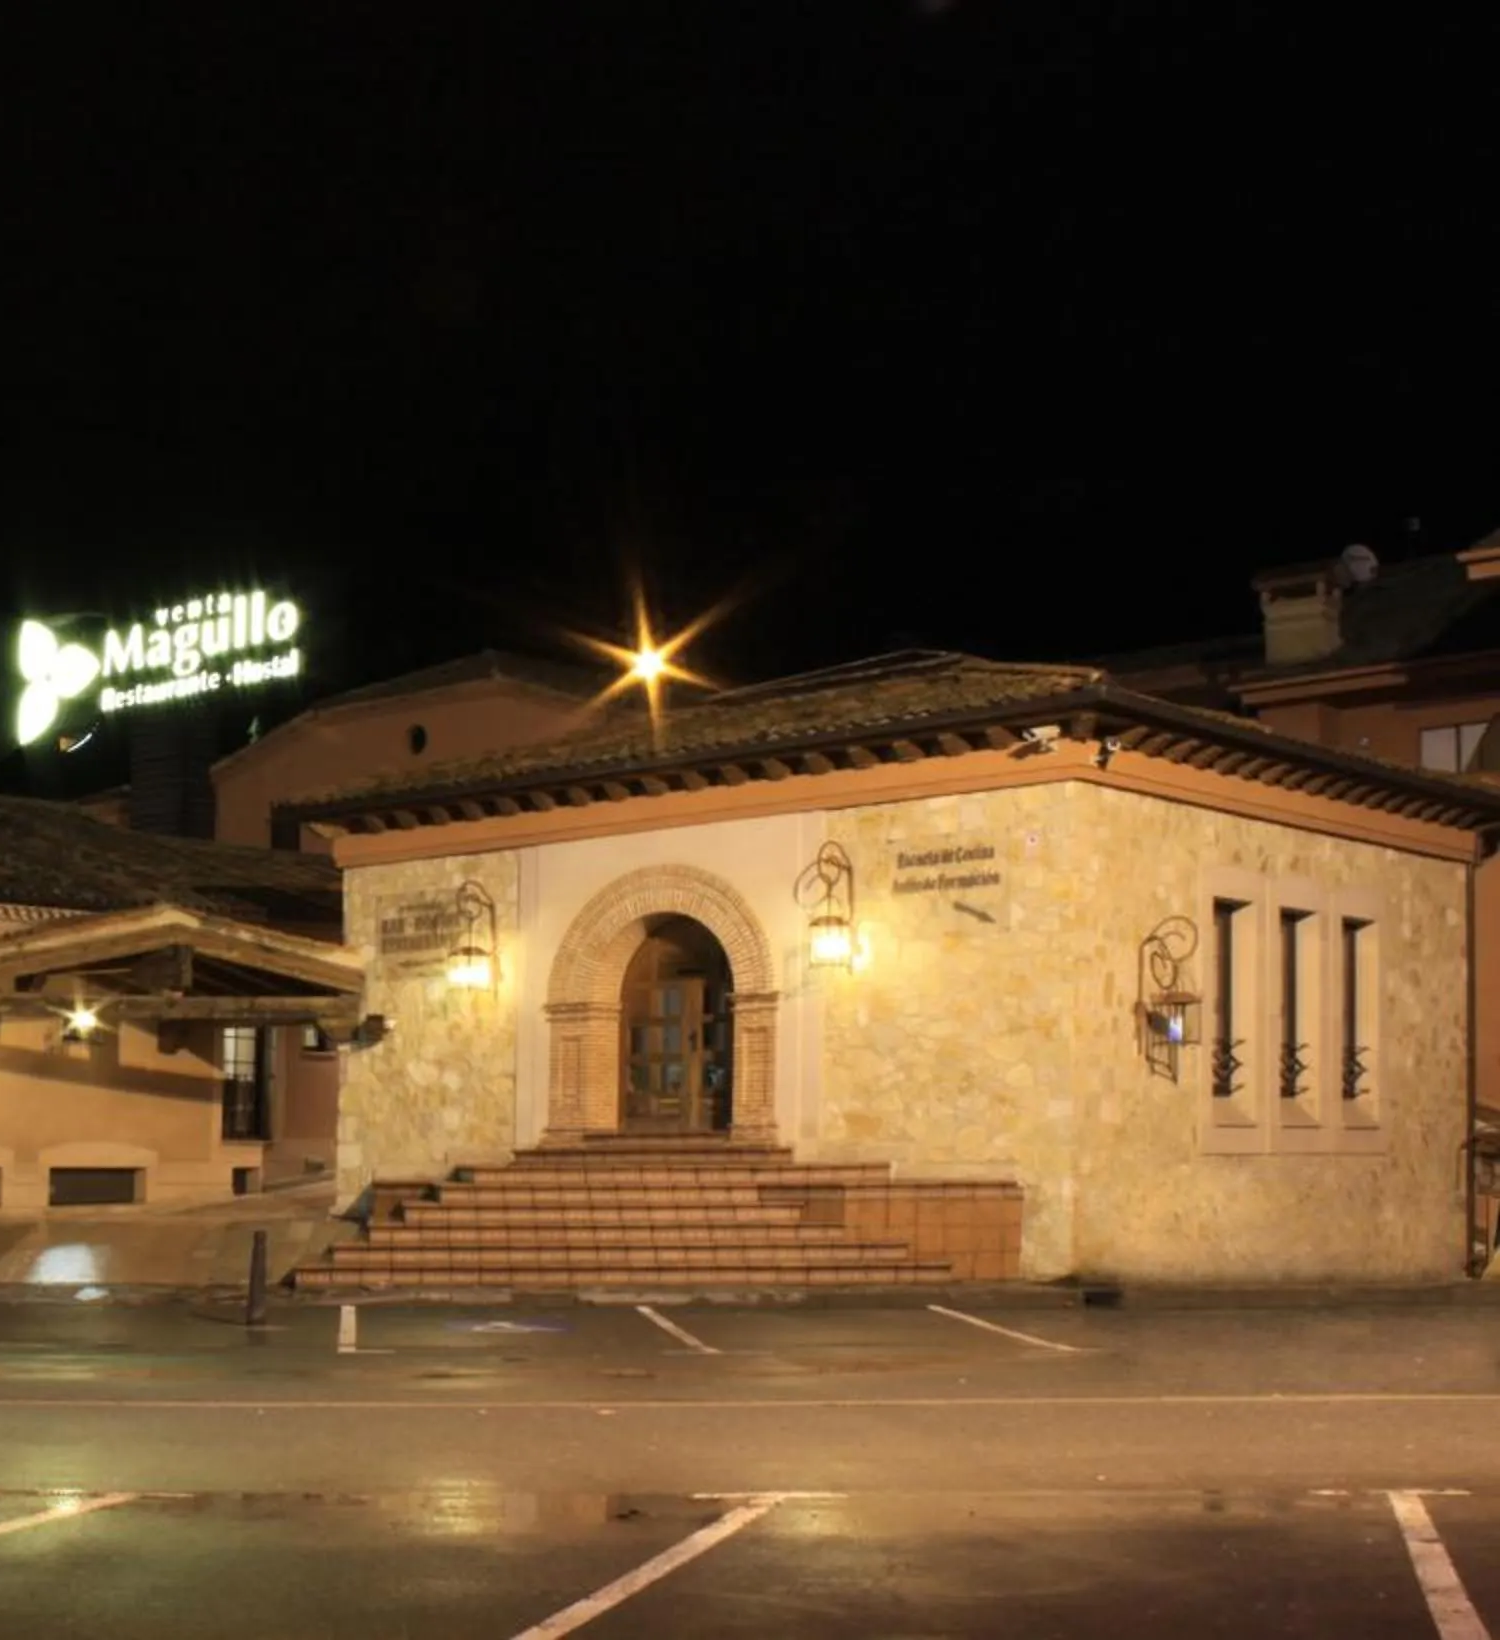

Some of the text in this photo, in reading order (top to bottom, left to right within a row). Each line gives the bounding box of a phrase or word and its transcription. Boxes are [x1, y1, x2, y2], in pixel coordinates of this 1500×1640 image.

[102, 589, 299, 677] Magullo
[155, 593, 232, 627] venta
[100, 648, 300, 712] Restaurante Hostal
